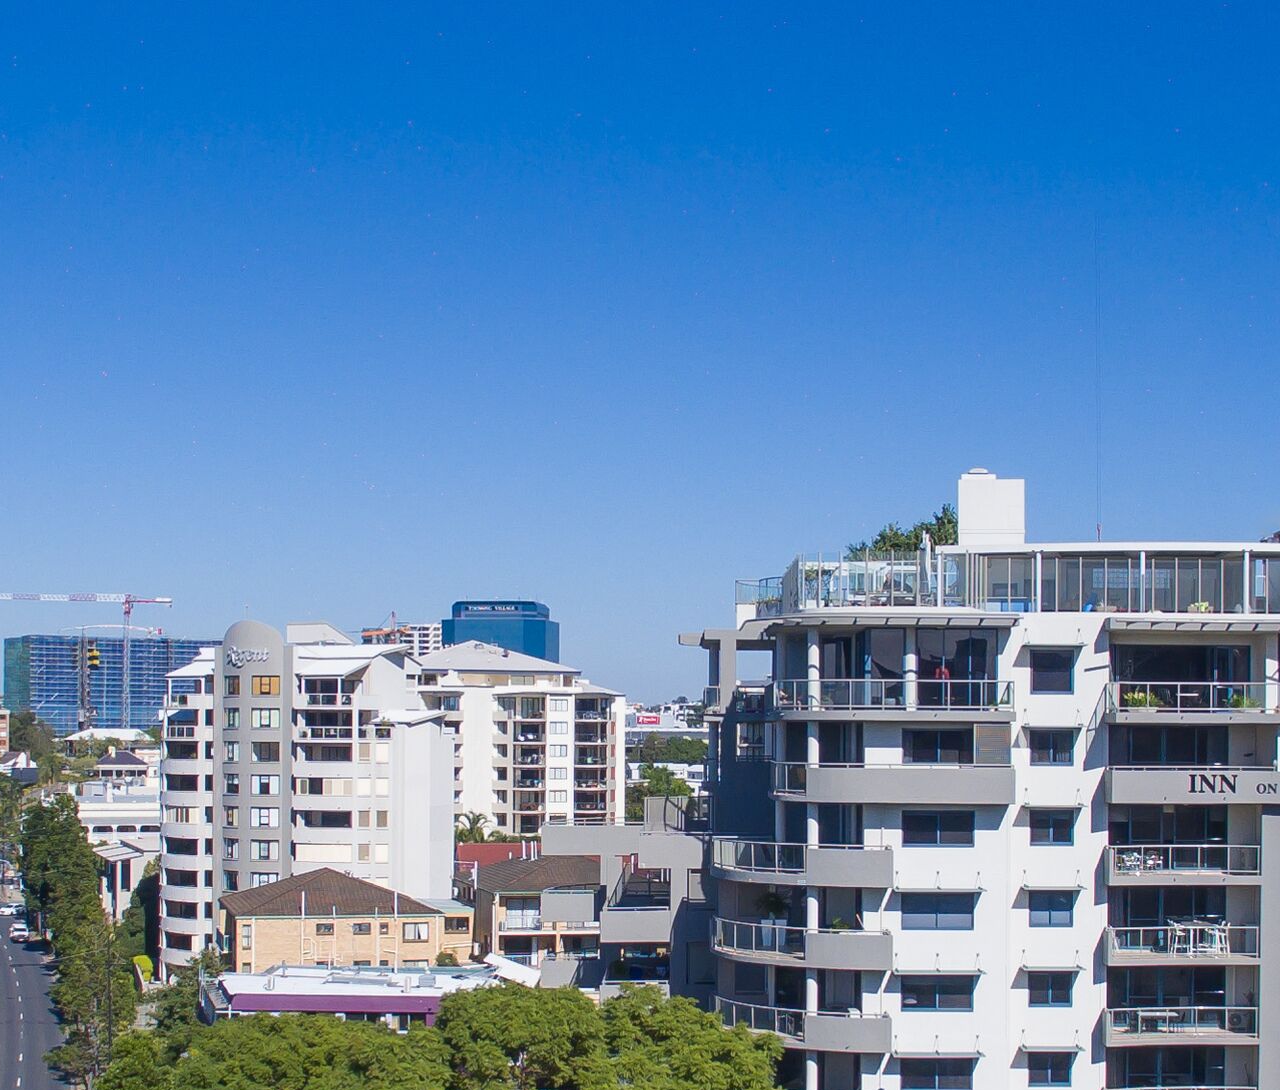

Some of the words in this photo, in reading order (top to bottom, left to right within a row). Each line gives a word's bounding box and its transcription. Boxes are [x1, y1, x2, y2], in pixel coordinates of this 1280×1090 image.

[226, 646, 270, 668] Regent
[1188, 774, 1238, 794] INN
[1256, 783, 1278, 794] ON
